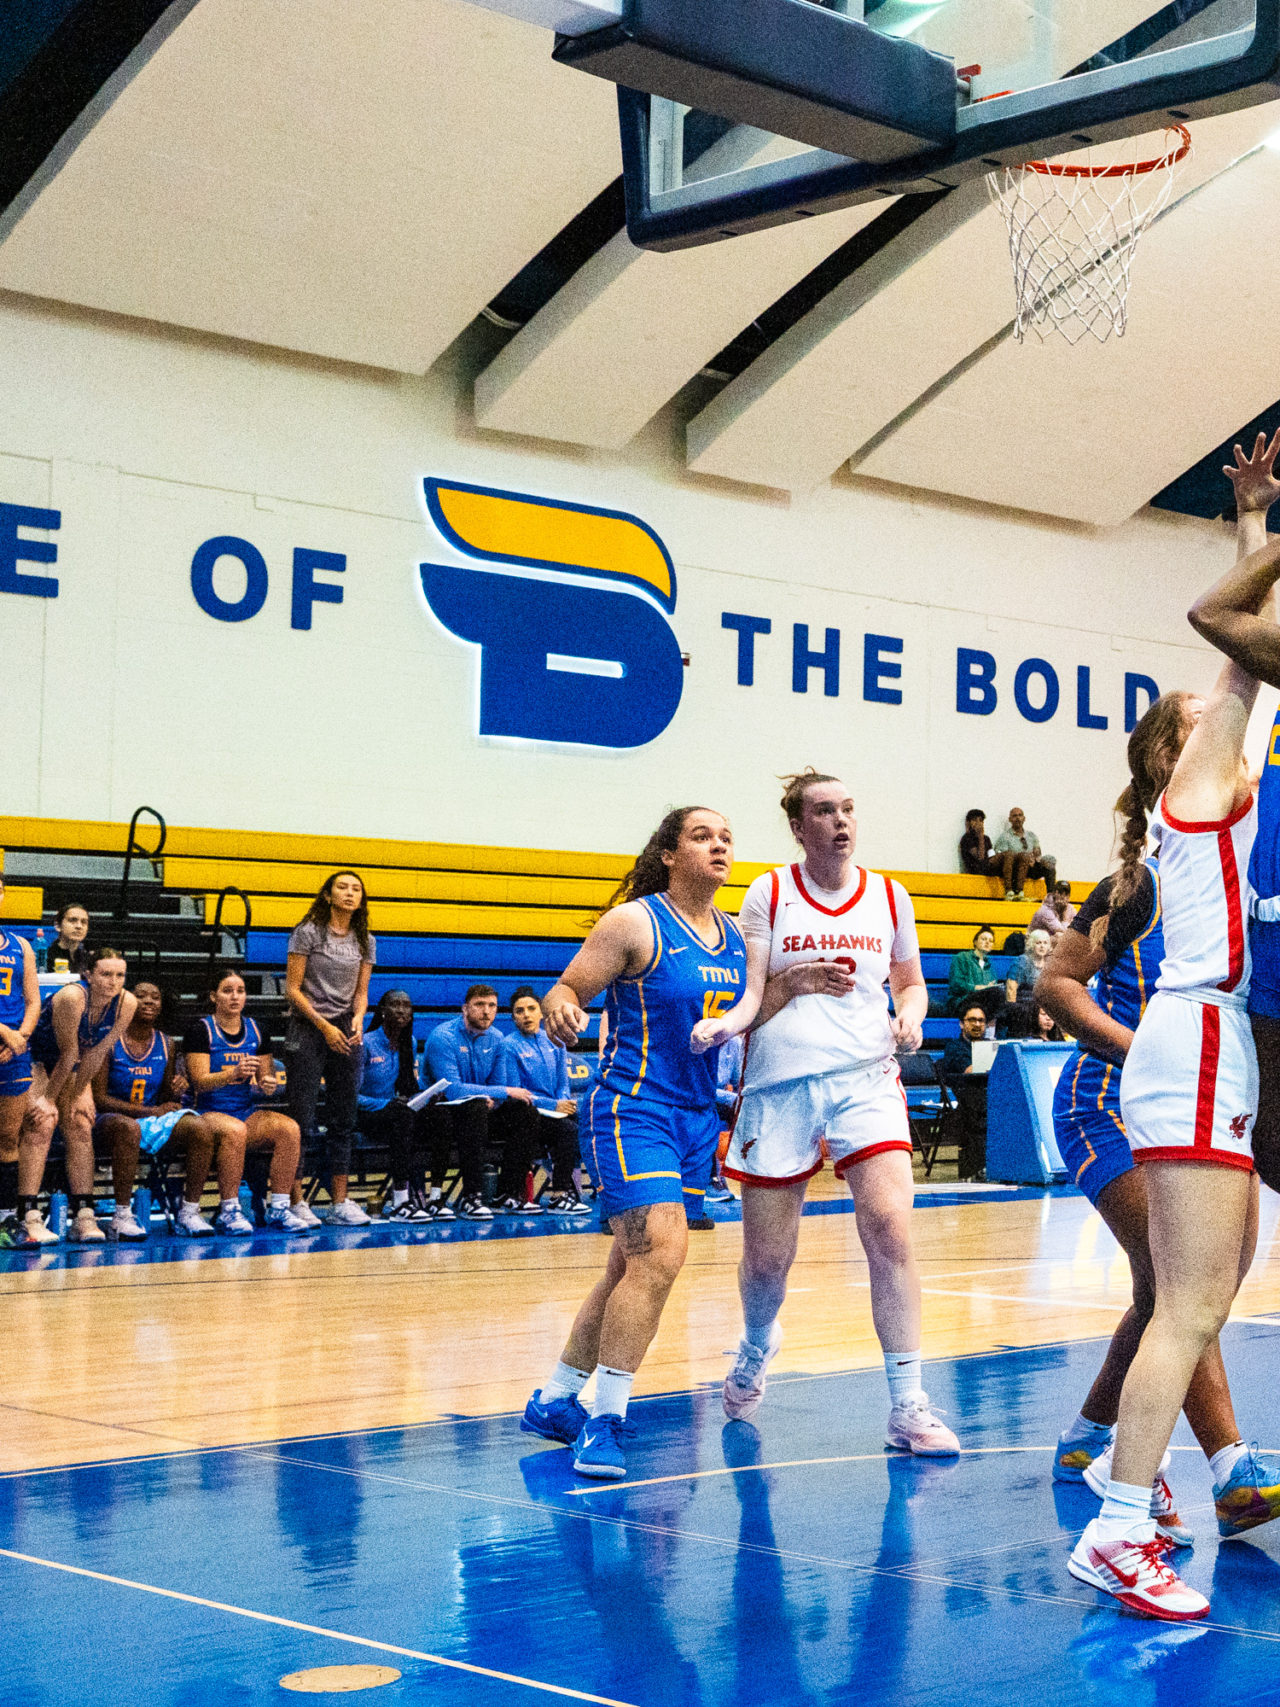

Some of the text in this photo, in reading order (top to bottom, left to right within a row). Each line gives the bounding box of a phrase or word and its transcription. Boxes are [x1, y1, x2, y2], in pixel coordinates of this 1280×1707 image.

[190, 535, 347, 630] OF
[721, 612, 1161, 733] THE BOLD
[698, 966, 740, 984] TMU
